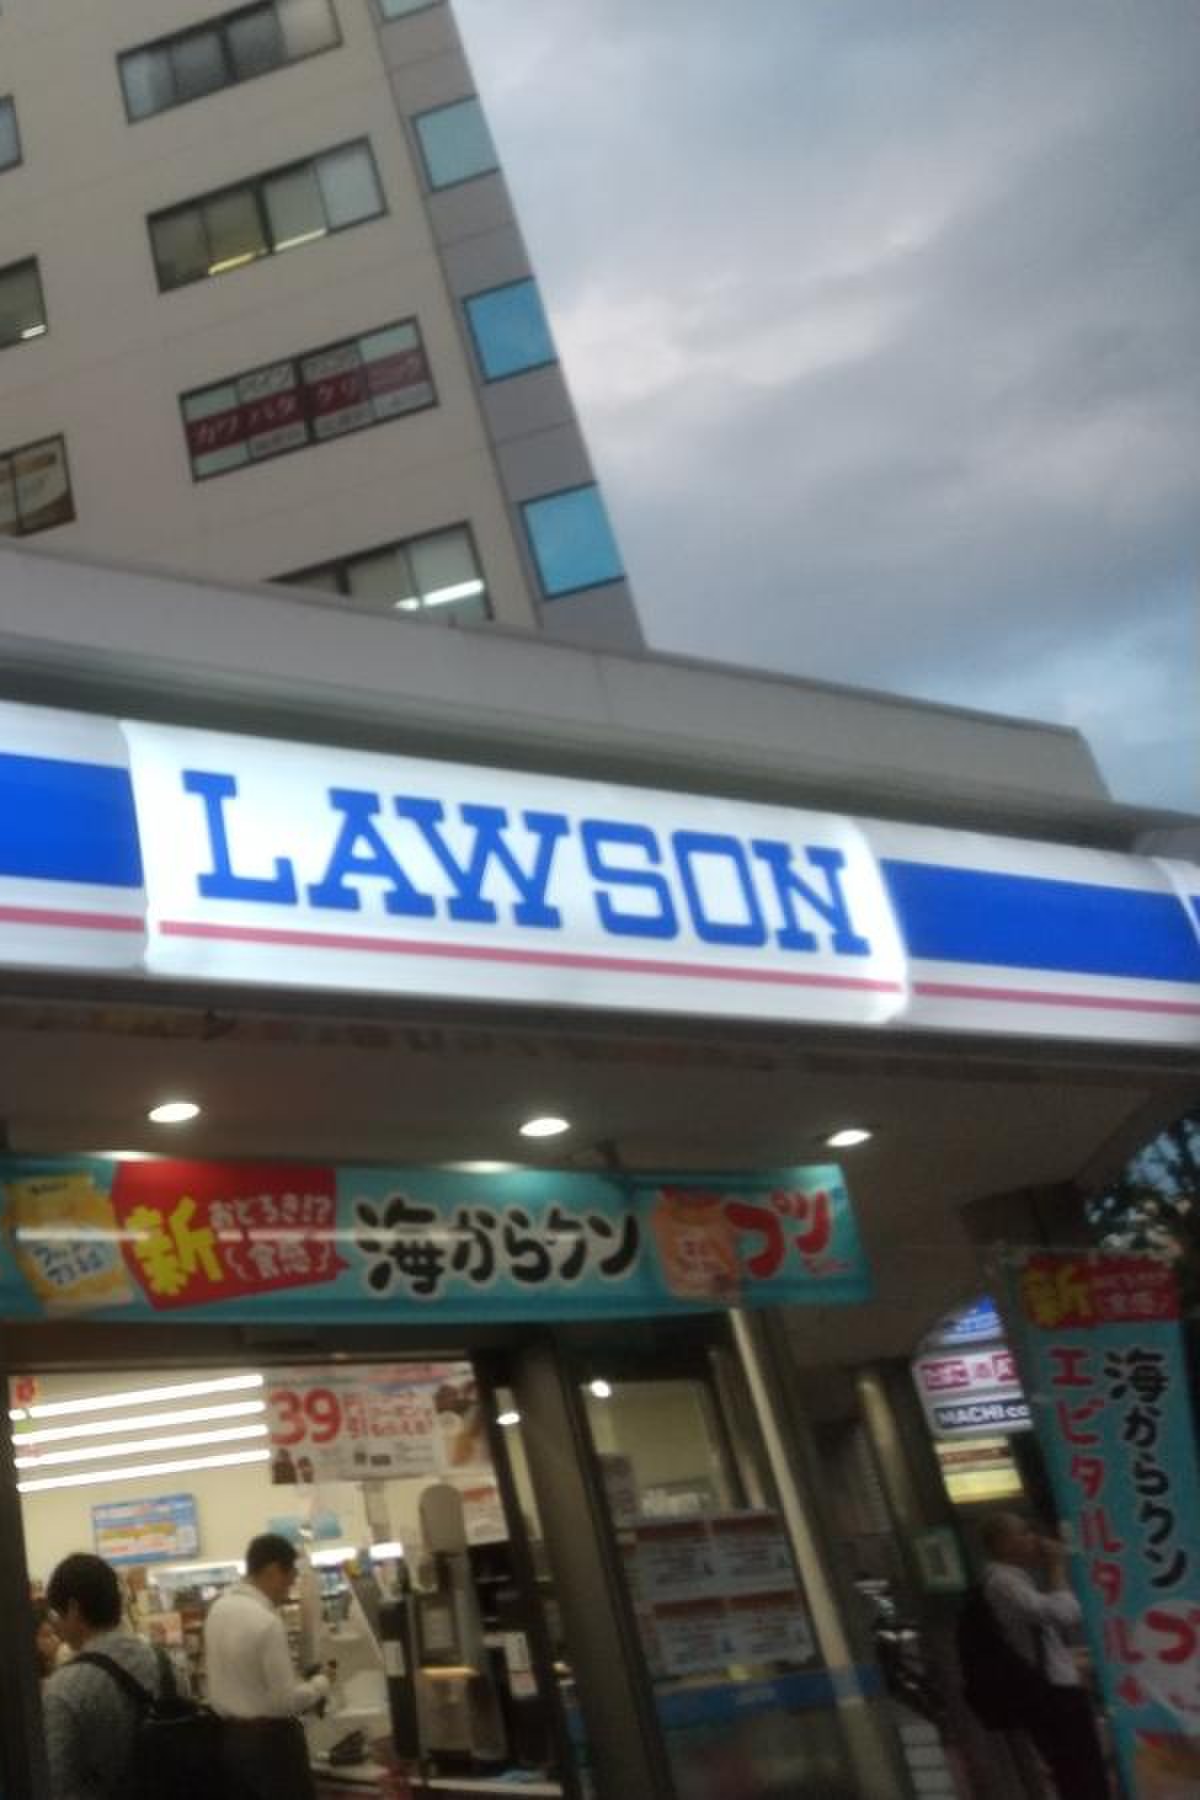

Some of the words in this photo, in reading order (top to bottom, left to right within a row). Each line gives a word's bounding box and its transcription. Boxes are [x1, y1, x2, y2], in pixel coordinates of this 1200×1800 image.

[182, 769, 873, 957] LAWSON
[125, 1195, 225, 1296] 新
[355, 1196, 640, 1295] 海からケン
[269, 1386, 341, 1446] 39
[1103, 1346, 1187, 1588] 海からケン
